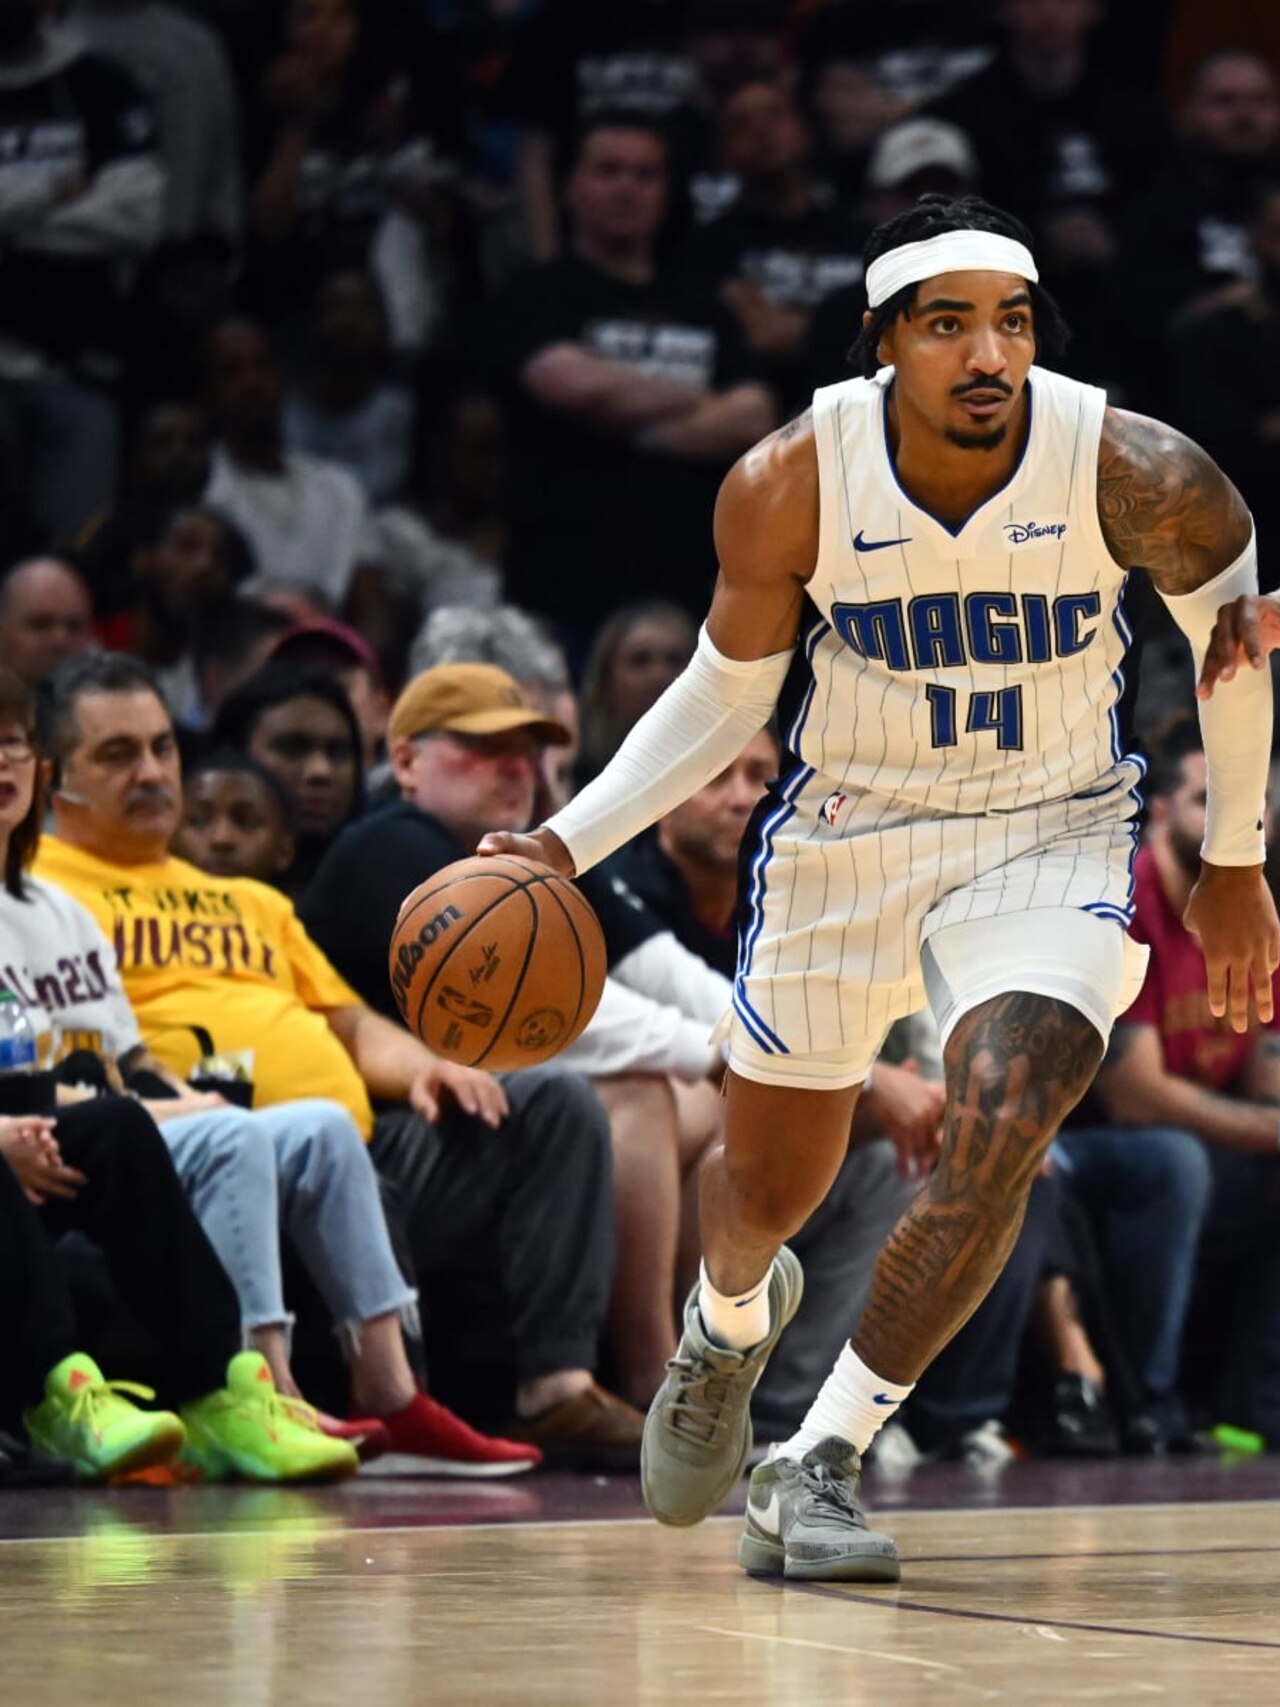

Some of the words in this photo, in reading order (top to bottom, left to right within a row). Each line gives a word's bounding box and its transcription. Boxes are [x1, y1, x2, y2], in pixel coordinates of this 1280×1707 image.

[1003, 521, 1067, 544] Disney
[831, 590, 1101, 672] MAGIC
[925, 683, 1024, 751] 14
